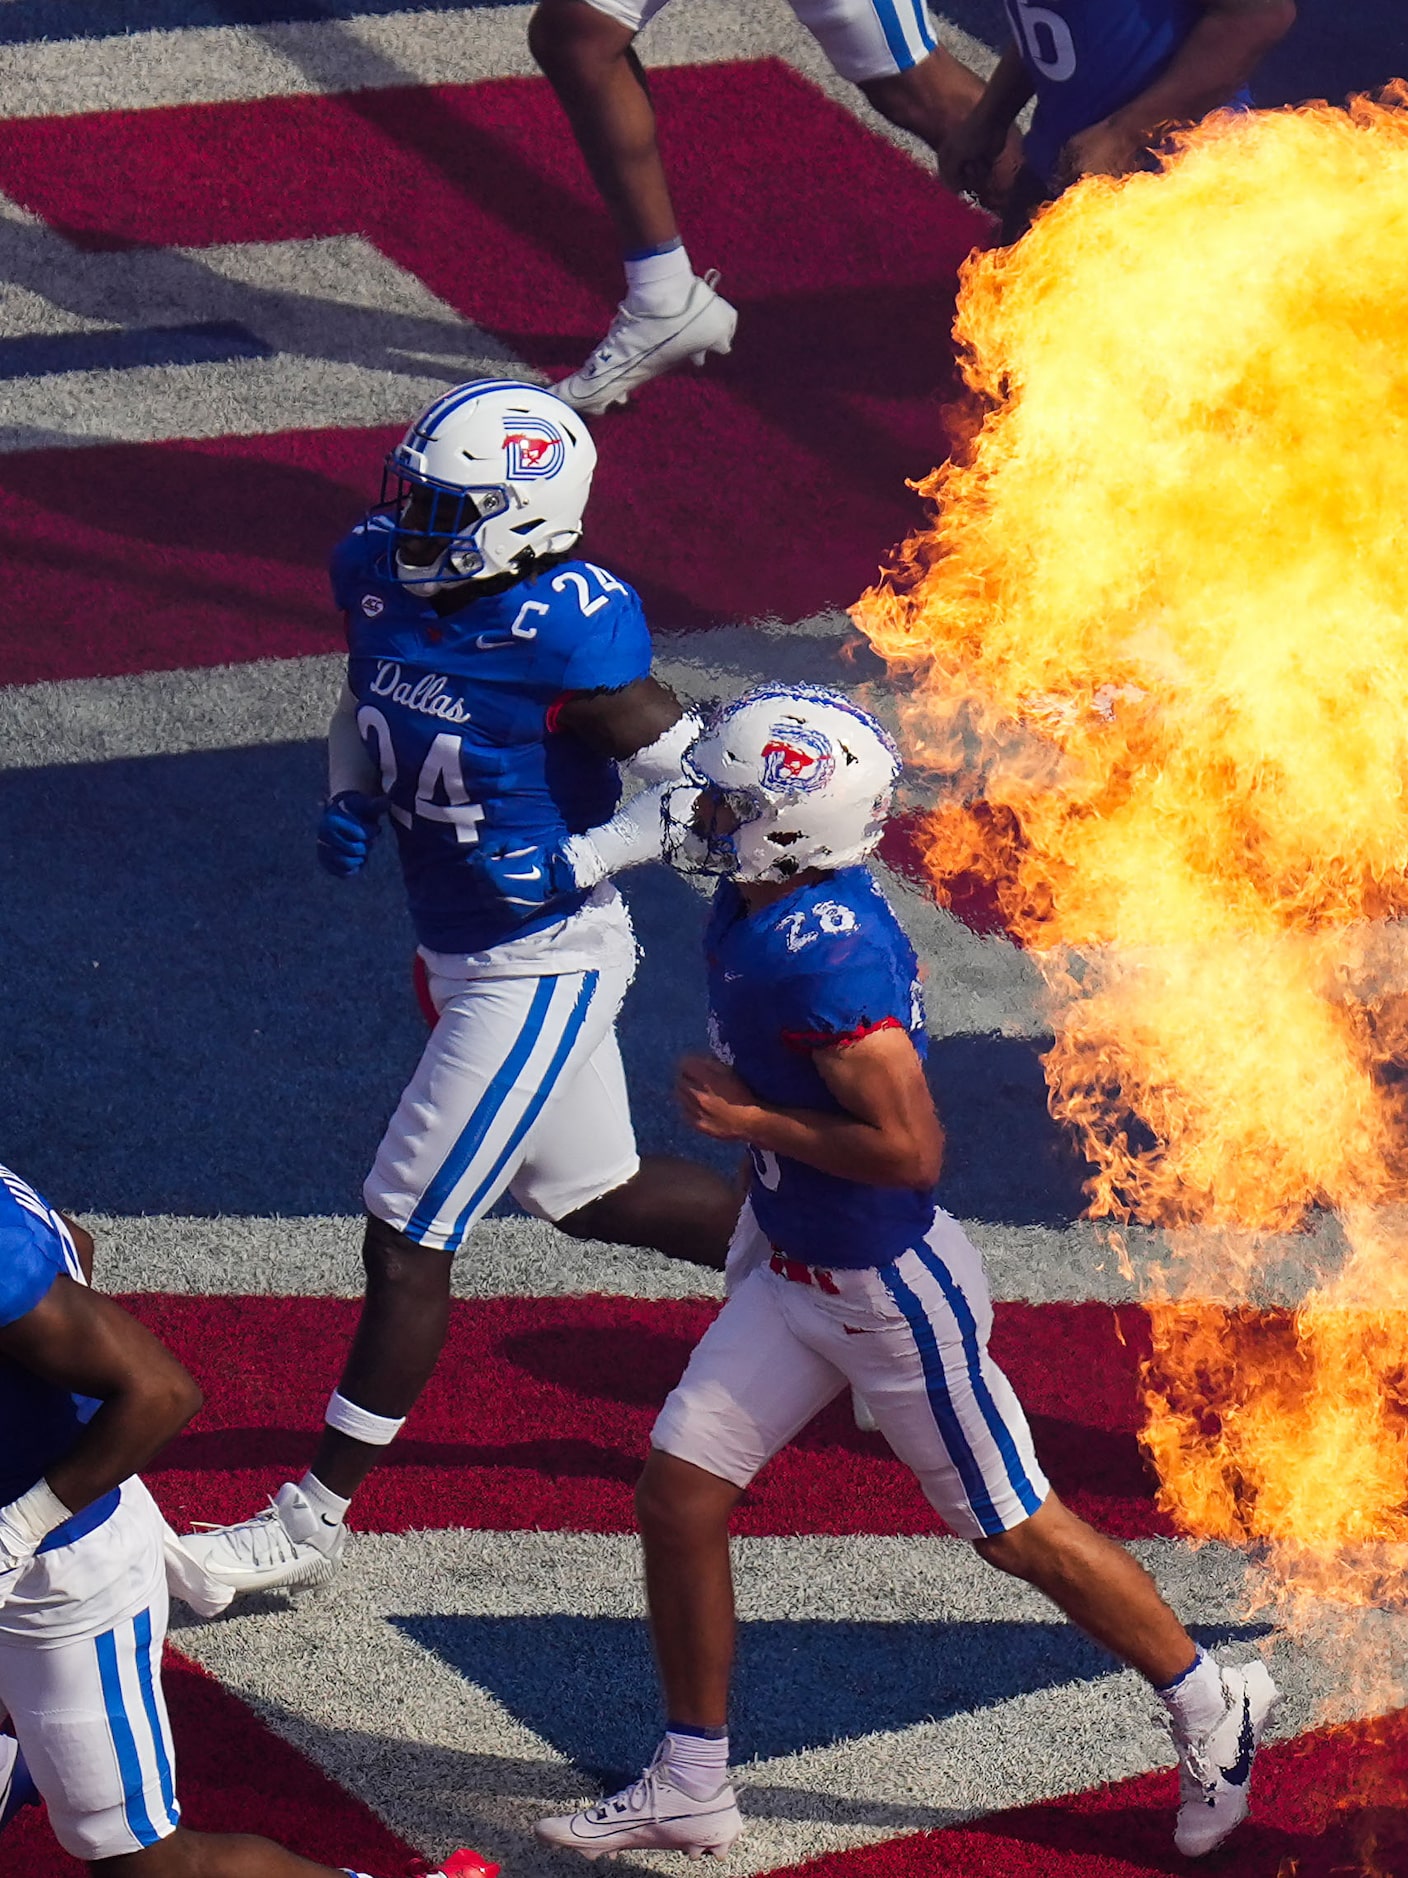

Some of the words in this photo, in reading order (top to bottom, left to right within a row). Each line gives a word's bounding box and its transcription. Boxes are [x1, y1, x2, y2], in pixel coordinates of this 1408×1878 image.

[1003, 0, 1077, 82] 6
[511, 600, 549, 638] C
[551, 562, 628, 617] 24
[369, 659, 471, 724] Dallas
[357, 704, 486, 843] 24
[774, 900, 861, 953] 28
